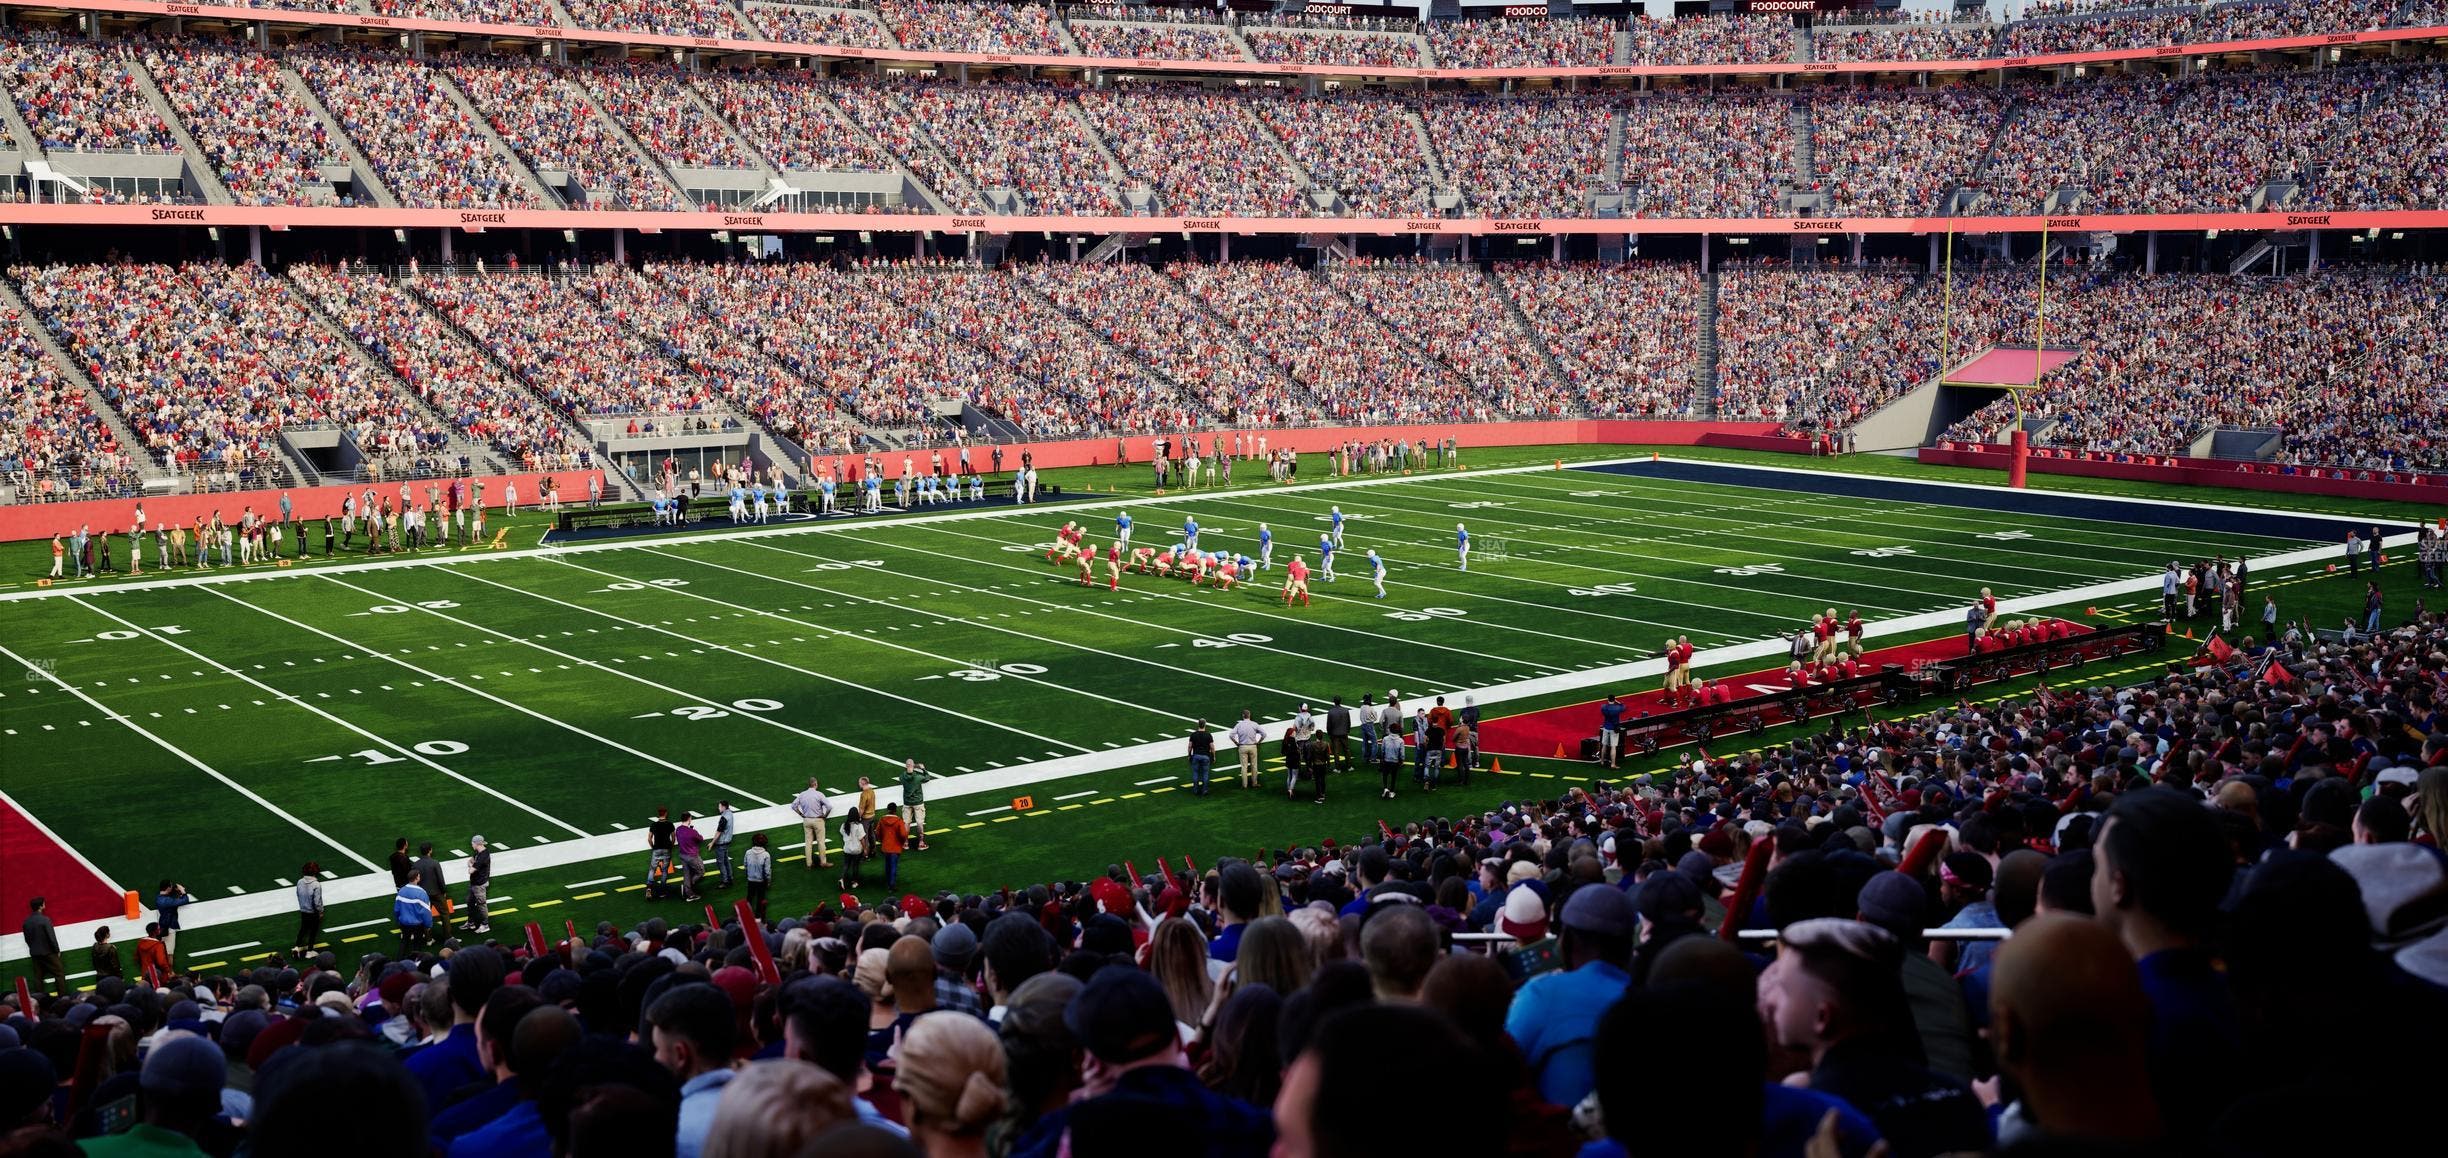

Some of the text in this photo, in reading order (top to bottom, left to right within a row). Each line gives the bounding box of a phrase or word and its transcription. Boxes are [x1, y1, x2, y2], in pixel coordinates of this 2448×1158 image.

[166, 4, 199, 14] SEATGEEK
[1751, 1, 1815, 11] FOODCOURT
[360, 17, 390, 26] SEATGEEK
[535, 28, 562, 37] SEATGEEK
[694, 38, 719, 47] SEATGEEK
[2327, 34, 2357, 43] SEATGEEK
[840, 48, 863, 56] SEATGEEK
[2156, 47, 2183, 55] SEATGEEK
[987, 54, 1011, 62] SEATGEEK
[2004, 58, 2028, 66] SEATGEEK
[1599, 67, 1632, 75] SEATGEEK
[1804, 63, 1837, 71] SEATGEEK
[152, 209, 205, 221] SEATGEEK
[460, 212, 506, 224] SEATGEEK
[724, 216, 763, 226] SEATGEEK
[952, 218, 986, 228] SEATGEEK
[1183, 220, 1220, 229] SEATGEEK
[1793, 221, 1843, 230] SEATGEEK
[2287, 215, 2331, 226] SEATGEEK
[1407, 222, 1441, 231] SEATGEEK
[1494, 221, 1541, 231] SEATGEEK
[1382, 607, 1468, 621] 50
[1192, 633, 1274, 649] 40
[948, 663, 1049, 682] 30
[670, 698, 785, 721] 20
[349, 740, 470, 765] 10
[1019, 798, 1029, 808] 20
